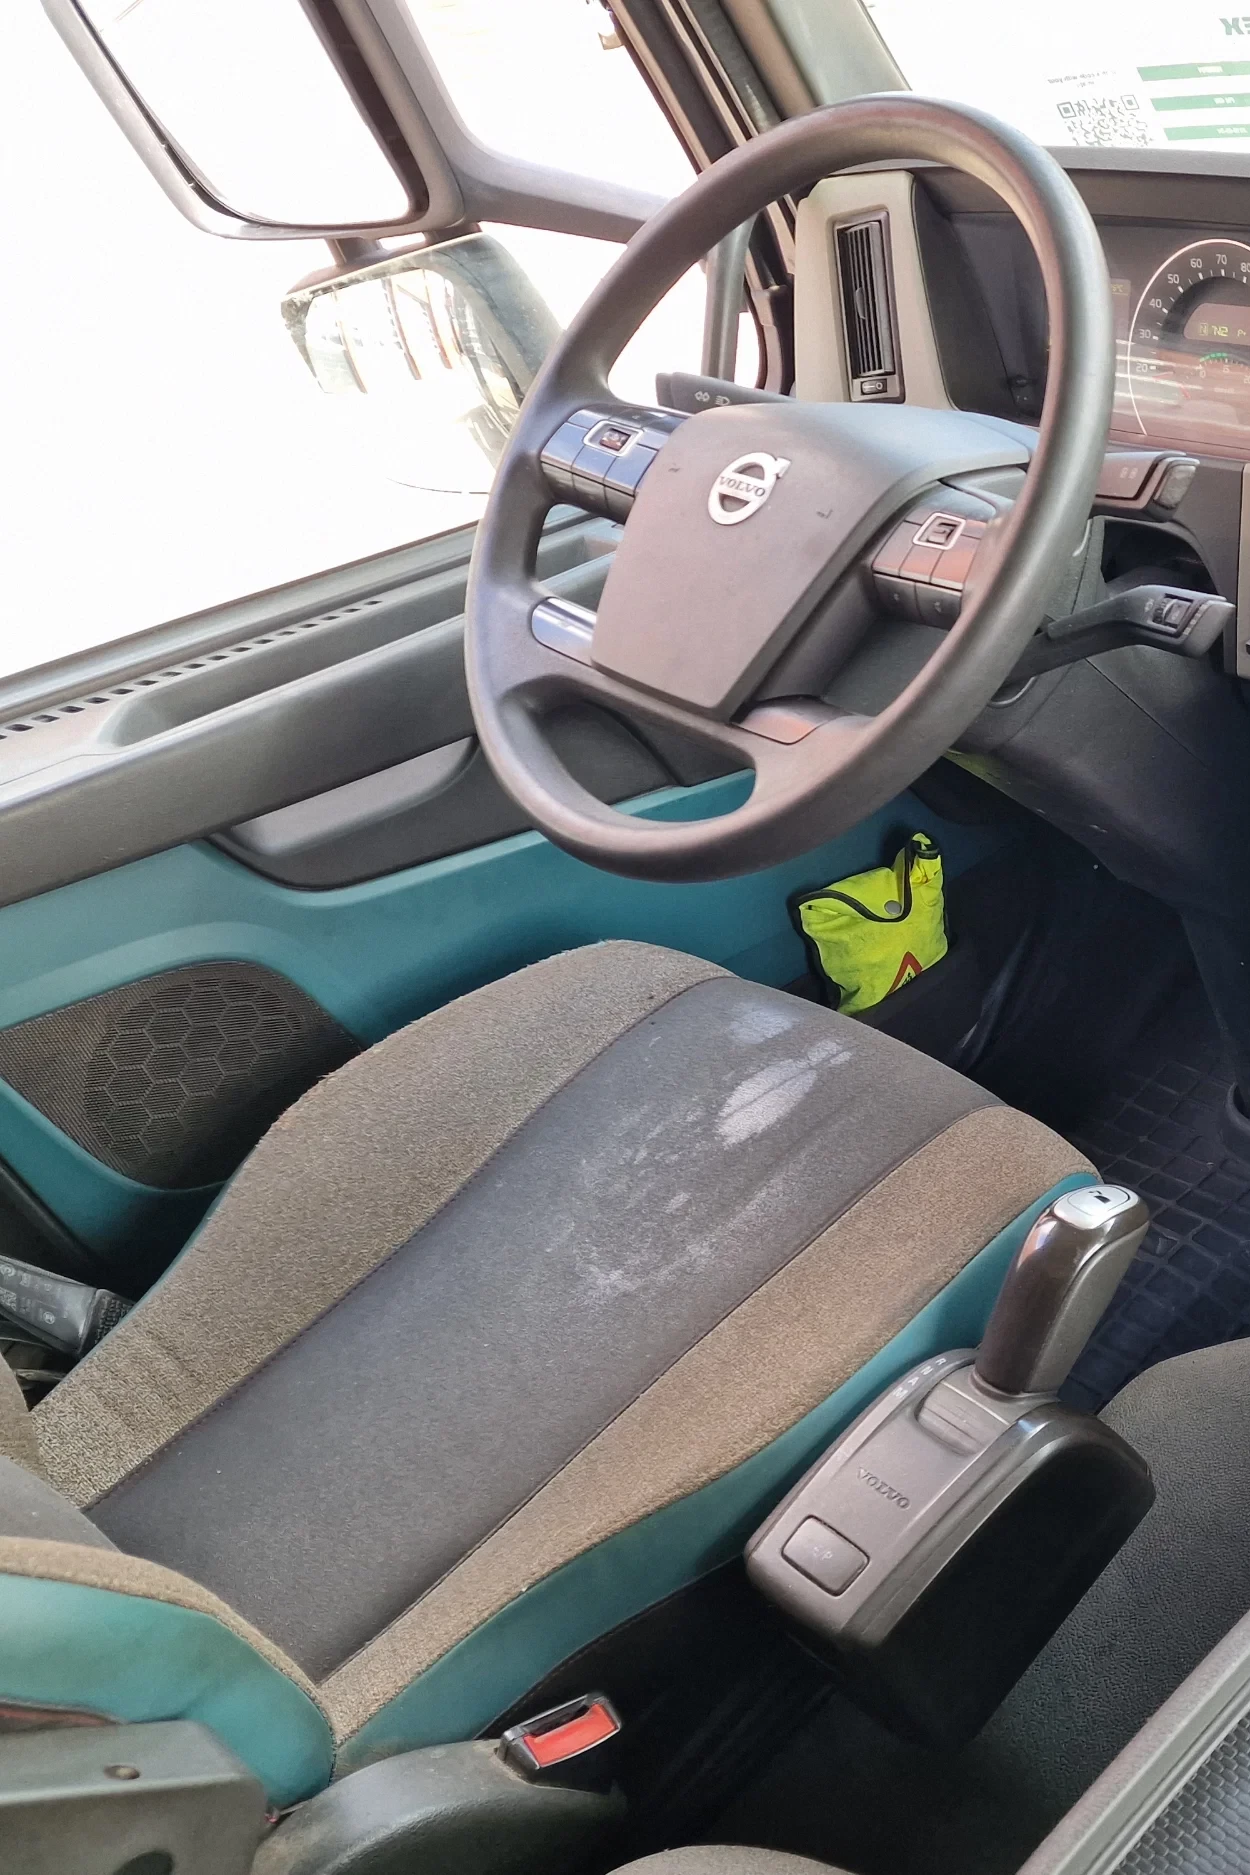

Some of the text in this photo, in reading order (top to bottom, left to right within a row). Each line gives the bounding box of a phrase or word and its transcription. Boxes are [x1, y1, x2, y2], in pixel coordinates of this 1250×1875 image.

[1190, 258, 1202, 268] 60
[1216, 254, 1228, 265] 70
[1167, 274, 1180, 284] 50
[1149, 298, 1162, 308] 40
[1139, 329, 1151, 338] 30
[1136, 363, 1147, 373] 20
[720, 476, 766, 497] VOLVO
[935, 1357, 946, 1365] R
[921, 1365, 934, 1376] N
[907, 1376, 919, 1387] A
[856, 1466, 911, 1510] VOLVO
